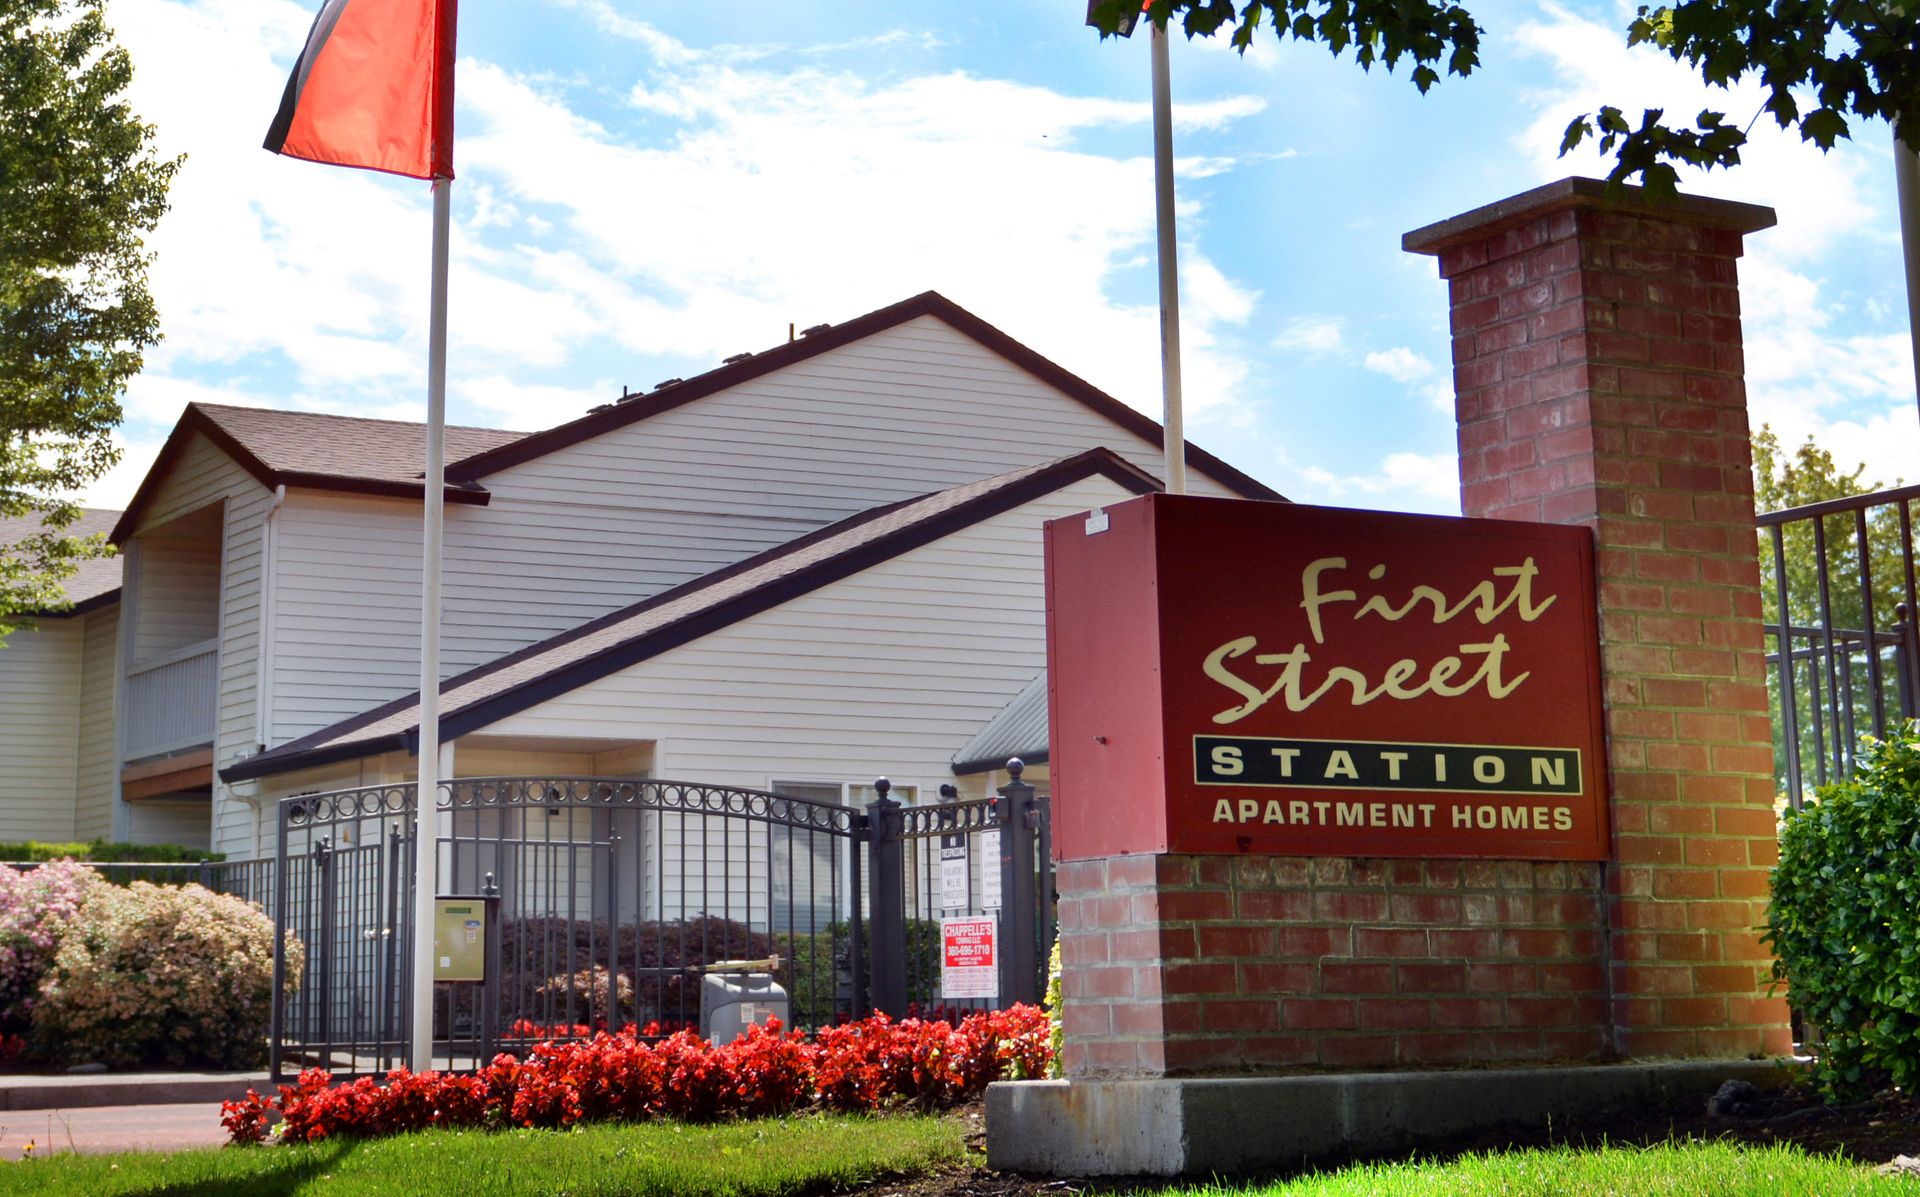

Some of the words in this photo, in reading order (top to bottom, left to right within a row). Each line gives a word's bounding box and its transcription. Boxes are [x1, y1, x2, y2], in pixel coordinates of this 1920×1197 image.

[1299, 556, 1557, 644] First
[1202, 633, 1530, 724] Street
[1211, 745, 1566, 786] STATION
[1213, 799, 1436, 828] APARTMENT
[1452, 805, 1572, 830] HOMES
[945, 924, 992, 937] CHAPPELLE'S
